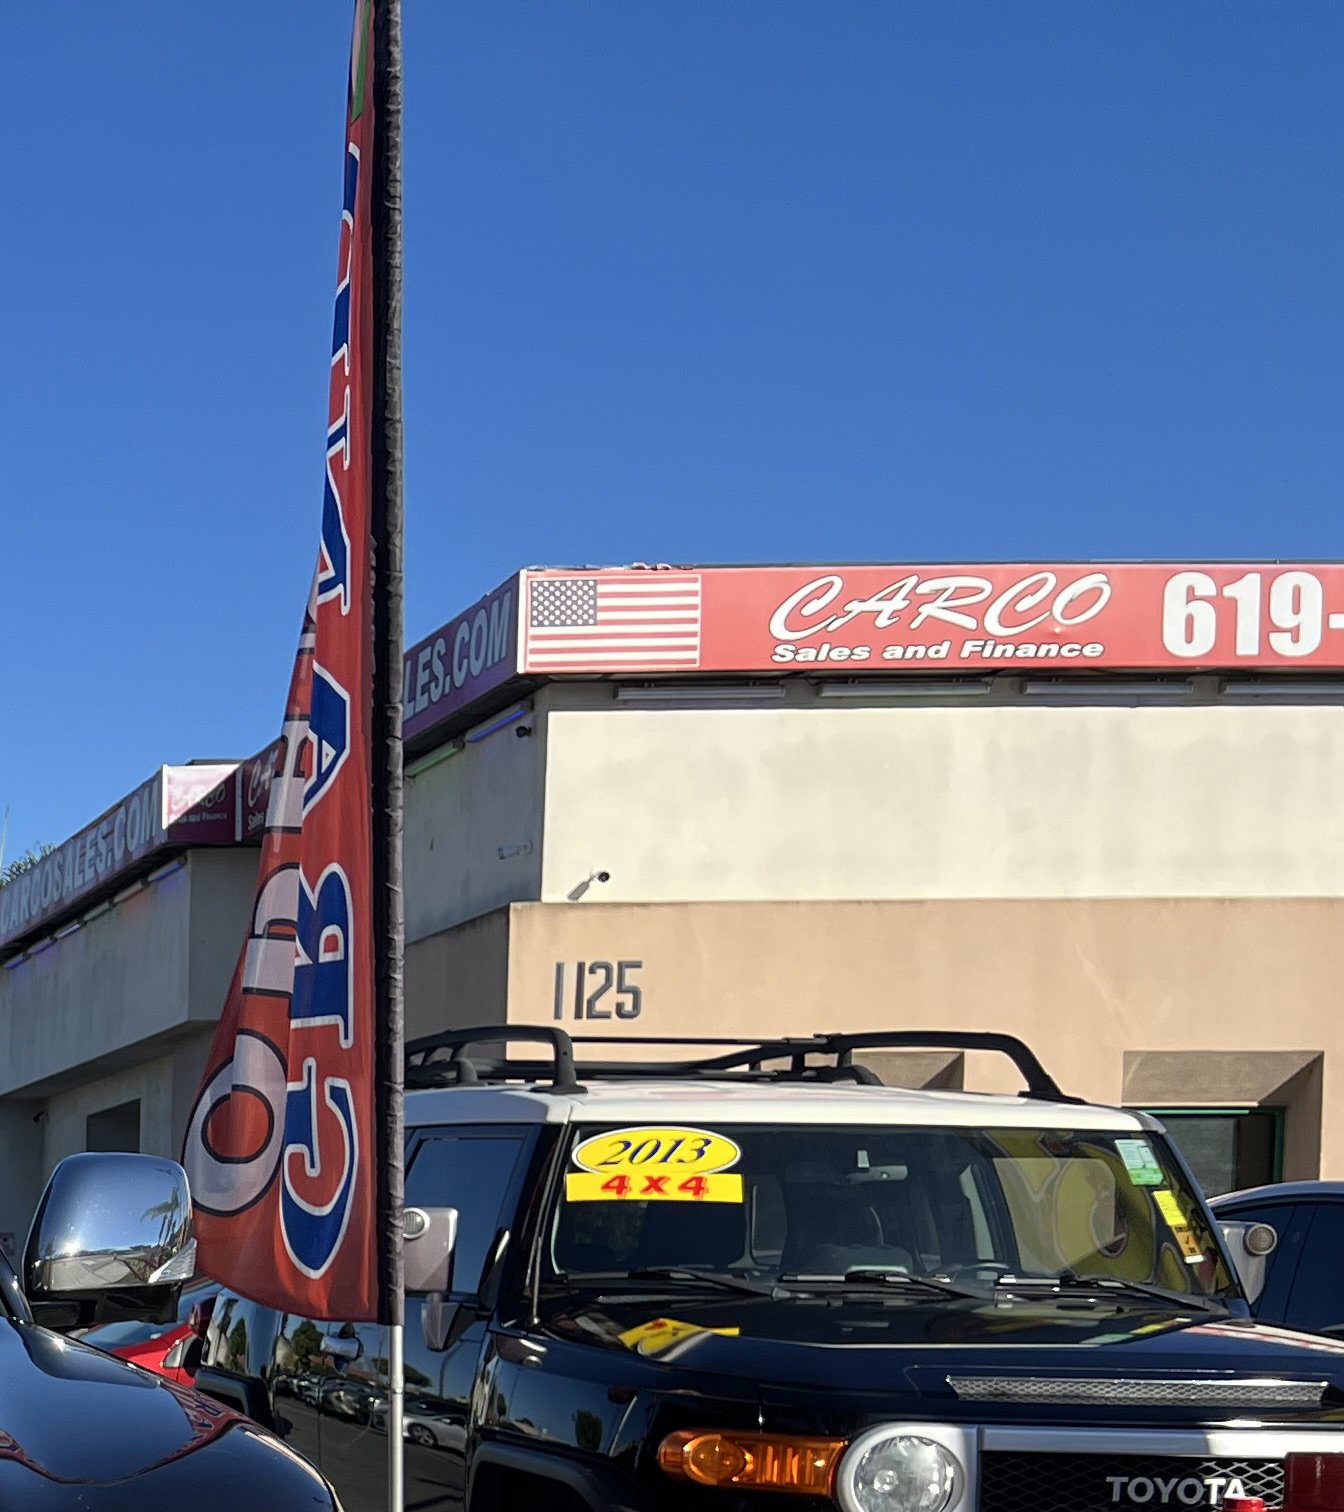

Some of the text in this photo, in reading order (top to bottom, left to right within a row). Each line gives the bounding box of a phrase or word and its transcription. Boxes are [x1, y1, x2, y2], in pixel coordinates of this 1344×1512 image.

[768, 571, 1112, 641] CARCO
[771, 639, 1105, 663] Sales and Finance
[553, 960, 643, 1020] 1125
[596, 1138, 713, 1166] 2013
[1105, 1476, 1246, 1505] TOYOTA
